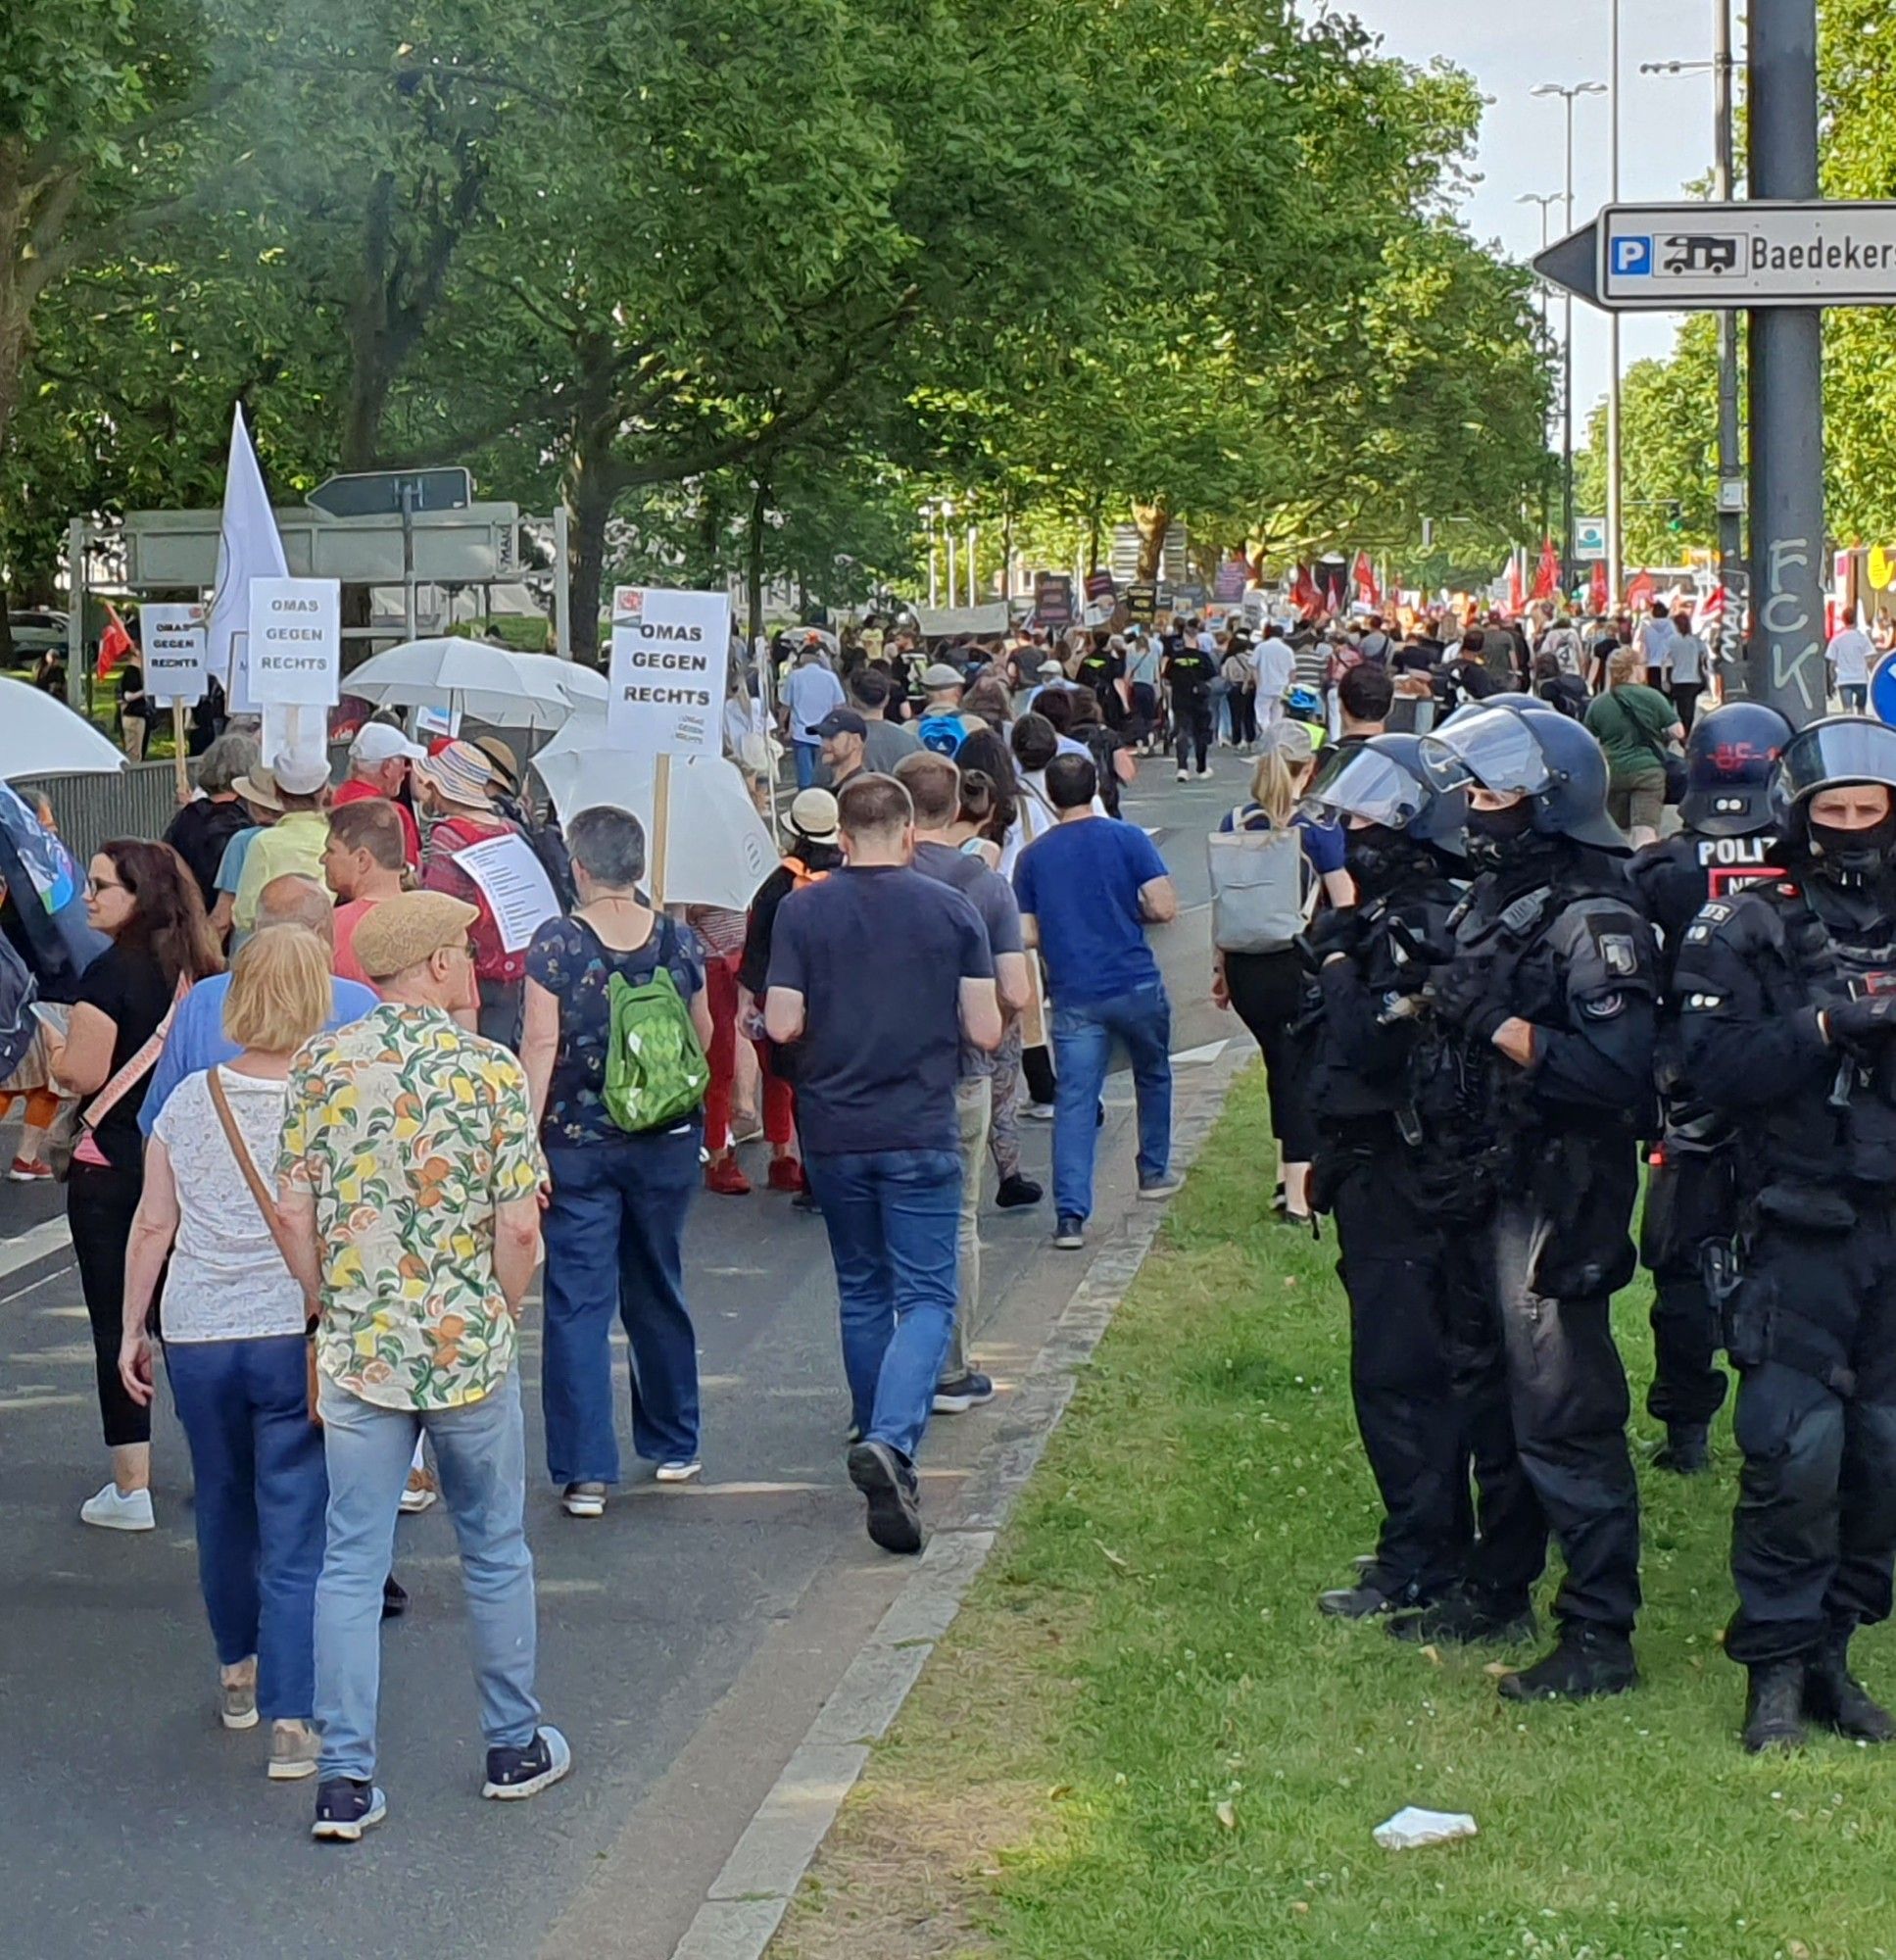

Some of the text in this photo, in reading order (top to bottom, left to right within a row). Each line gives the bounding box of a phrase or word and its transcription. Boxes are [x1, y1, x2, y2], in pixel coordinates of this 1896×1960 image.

[1752, 235, 1896, 270] Baedeker
[271, 600, 318, 612] OMAS
[156, 623, 189, 632] OMAS
[1762, 538, 1819, 710] FCK
[266, 628, 322, 641] GEGEN
[640, 624, 703, 642] OMAS
[153, 639, 194, 648] GEGEN
[151, 659, 197, 667] RECHTS
[262, 658, 327, 670] RECHTS
[632, 652, 706, 670] GEGEN
[624, 685, 710, 706] RECHTS
